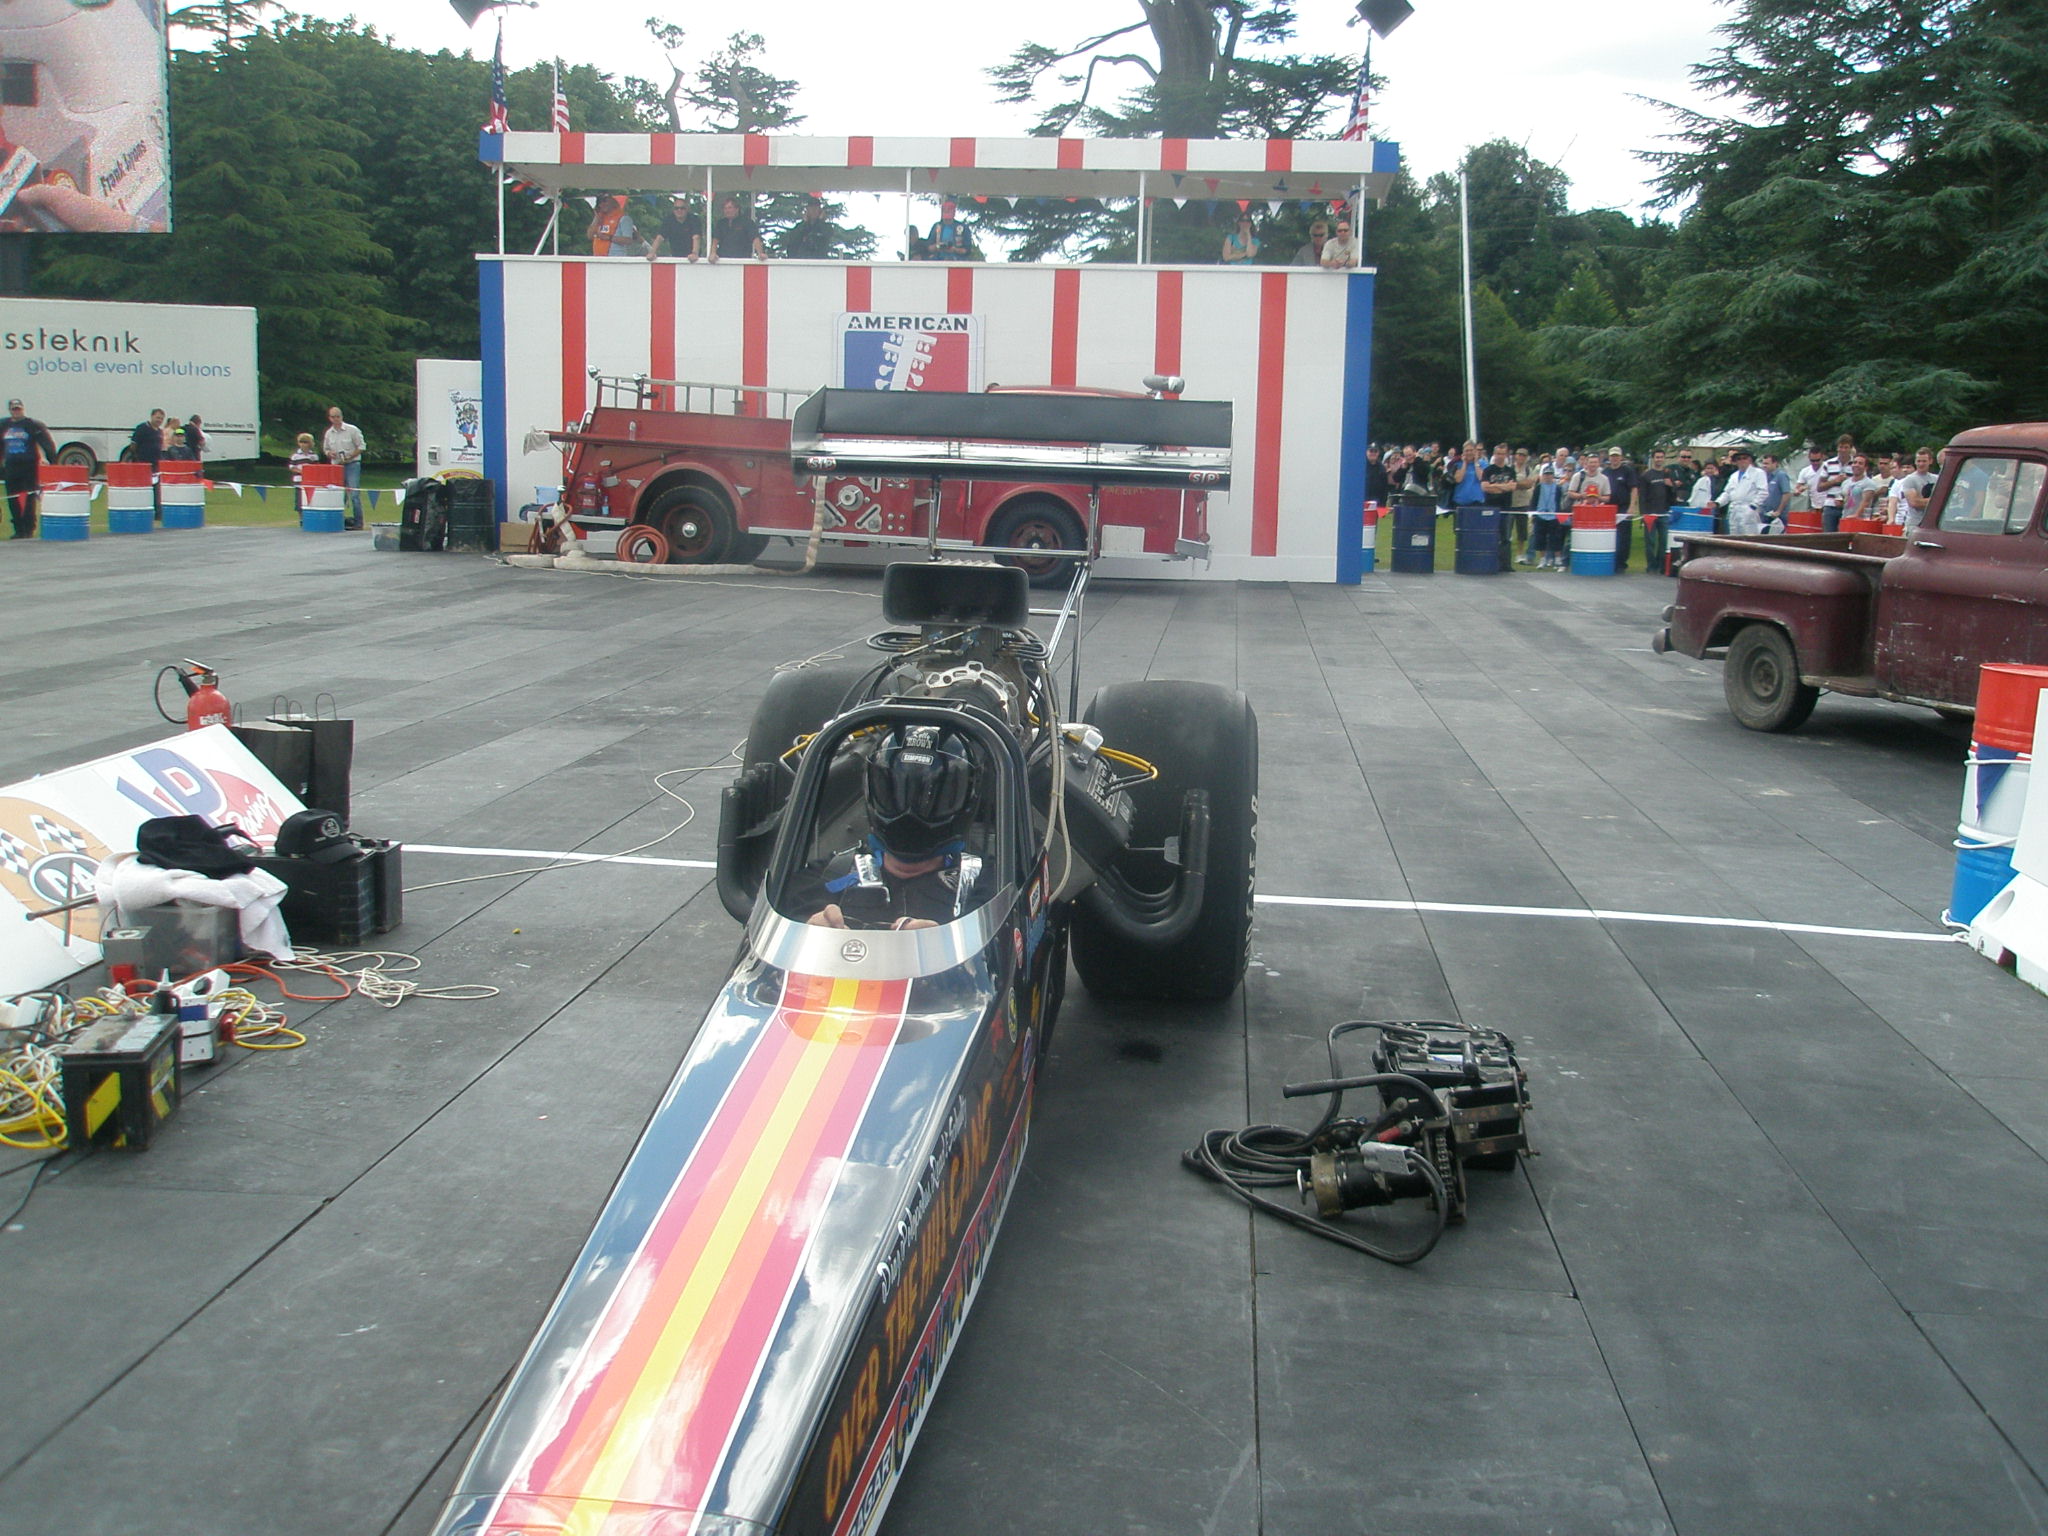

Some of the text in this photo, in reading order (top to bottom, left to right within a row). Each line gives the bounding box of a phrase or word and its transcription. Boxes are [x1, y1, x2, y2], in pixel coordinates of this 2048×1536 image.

[848, 316, 967, 330] AMERICAN
[27, 357, 232, 378] global event solutions
[810, 457, 834, 469] STP
[1192, 471, 1217, 483] STP
[904, 754, 931, 763] SIMPSON
[226, 793, 274, 836] Racing
[824, 1343, 882, 1521] OVER
[885, 1252, 919, 1387] THE
[919, 1180, 948, 1308] HILL
[948, 1081, 993, 1236] GANG
